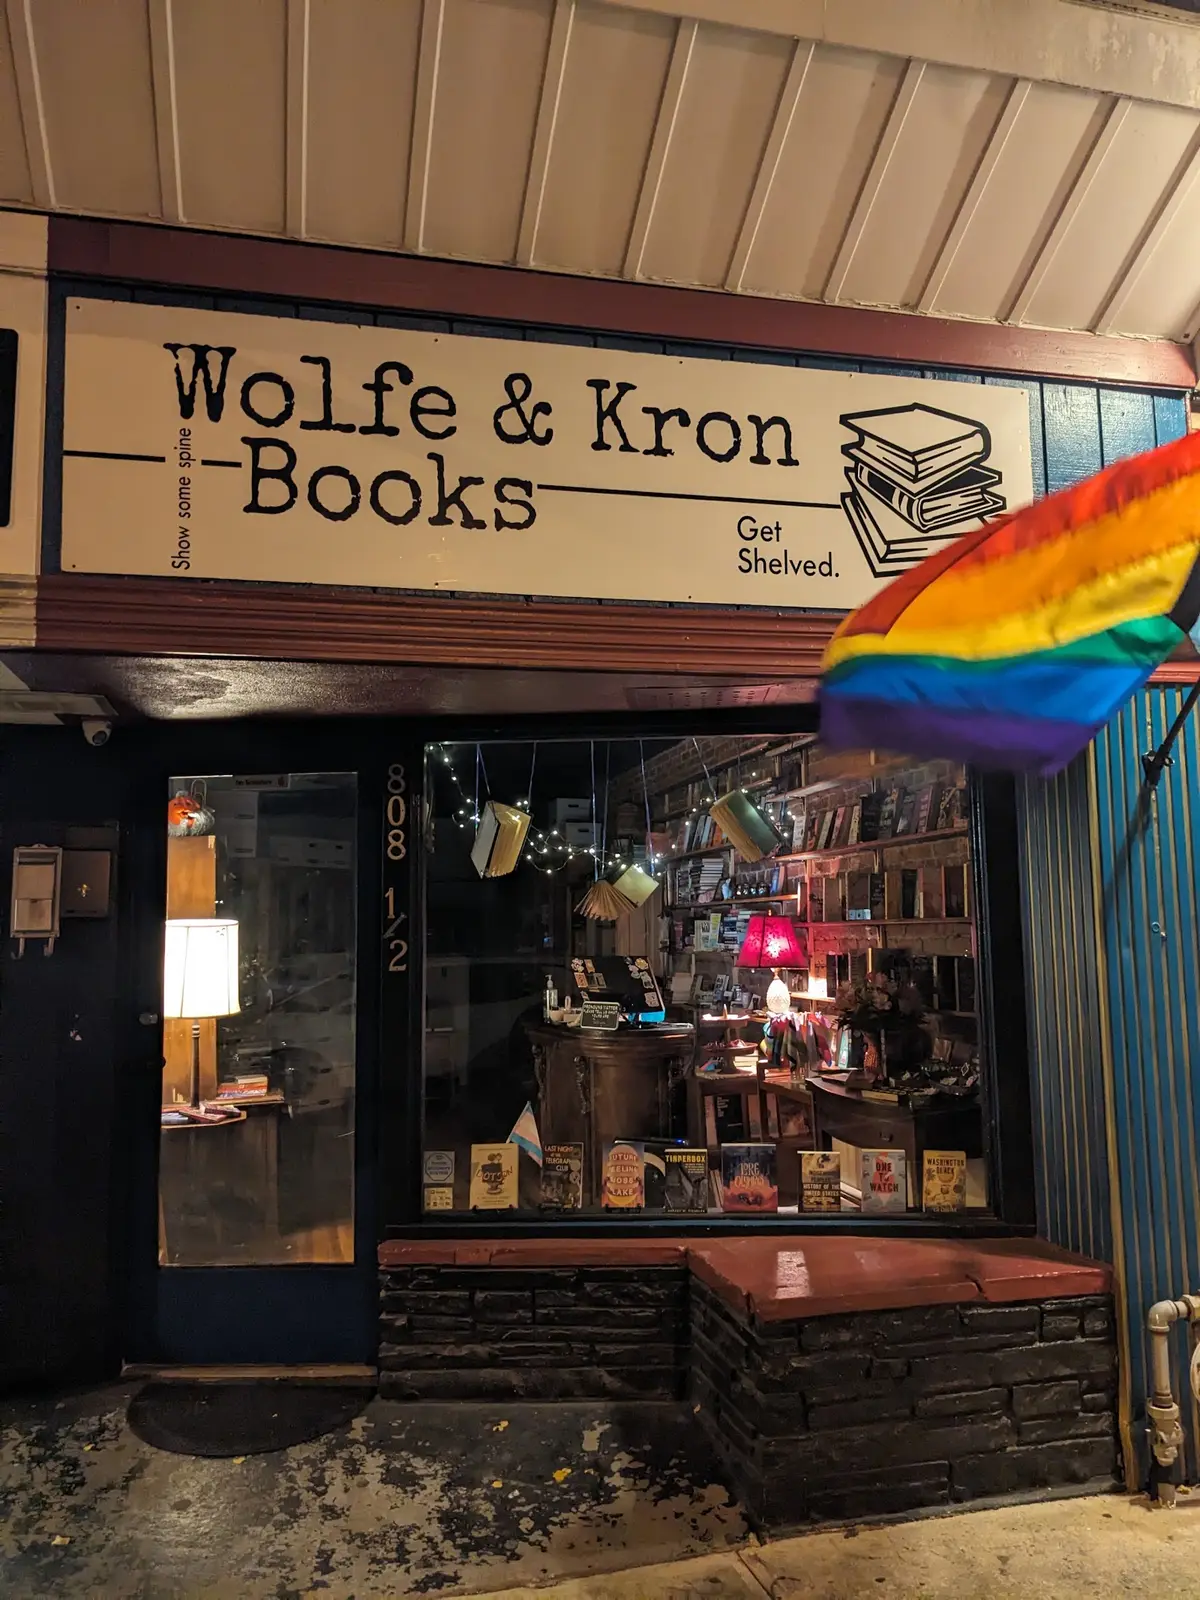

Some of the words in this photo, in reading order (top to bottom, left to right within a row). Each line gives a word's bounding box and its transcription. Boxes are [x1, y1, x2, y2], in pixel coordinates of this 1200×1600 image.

[162, 342, 457, 441] Wolfe
[493, 372, 554, 447] &
[585, 378, 800, 467] Kron
[173, 427, 197, 469] spine
[178, 476, 192, 519] some
[240, 436, 537, 532] Books
[737, 515, 782, 542] Get
[170, 525, 191, 571] Show
[738, 547, 840, 578] Shelved.
[386, 763, 407, 861] 808
[665, 1154, 706, 1163] TINDERBOX
[740, 1162, 759, 1176] LORE
[875, 1162, 892, 1172] ONE
[927, 1157, 965, 1166] WASHINGTON
[869, 1182, 899, 1193] WATCH
[878, 1172, 890, 1182] TO
[612, 1188, 634, 1196] LAKE
